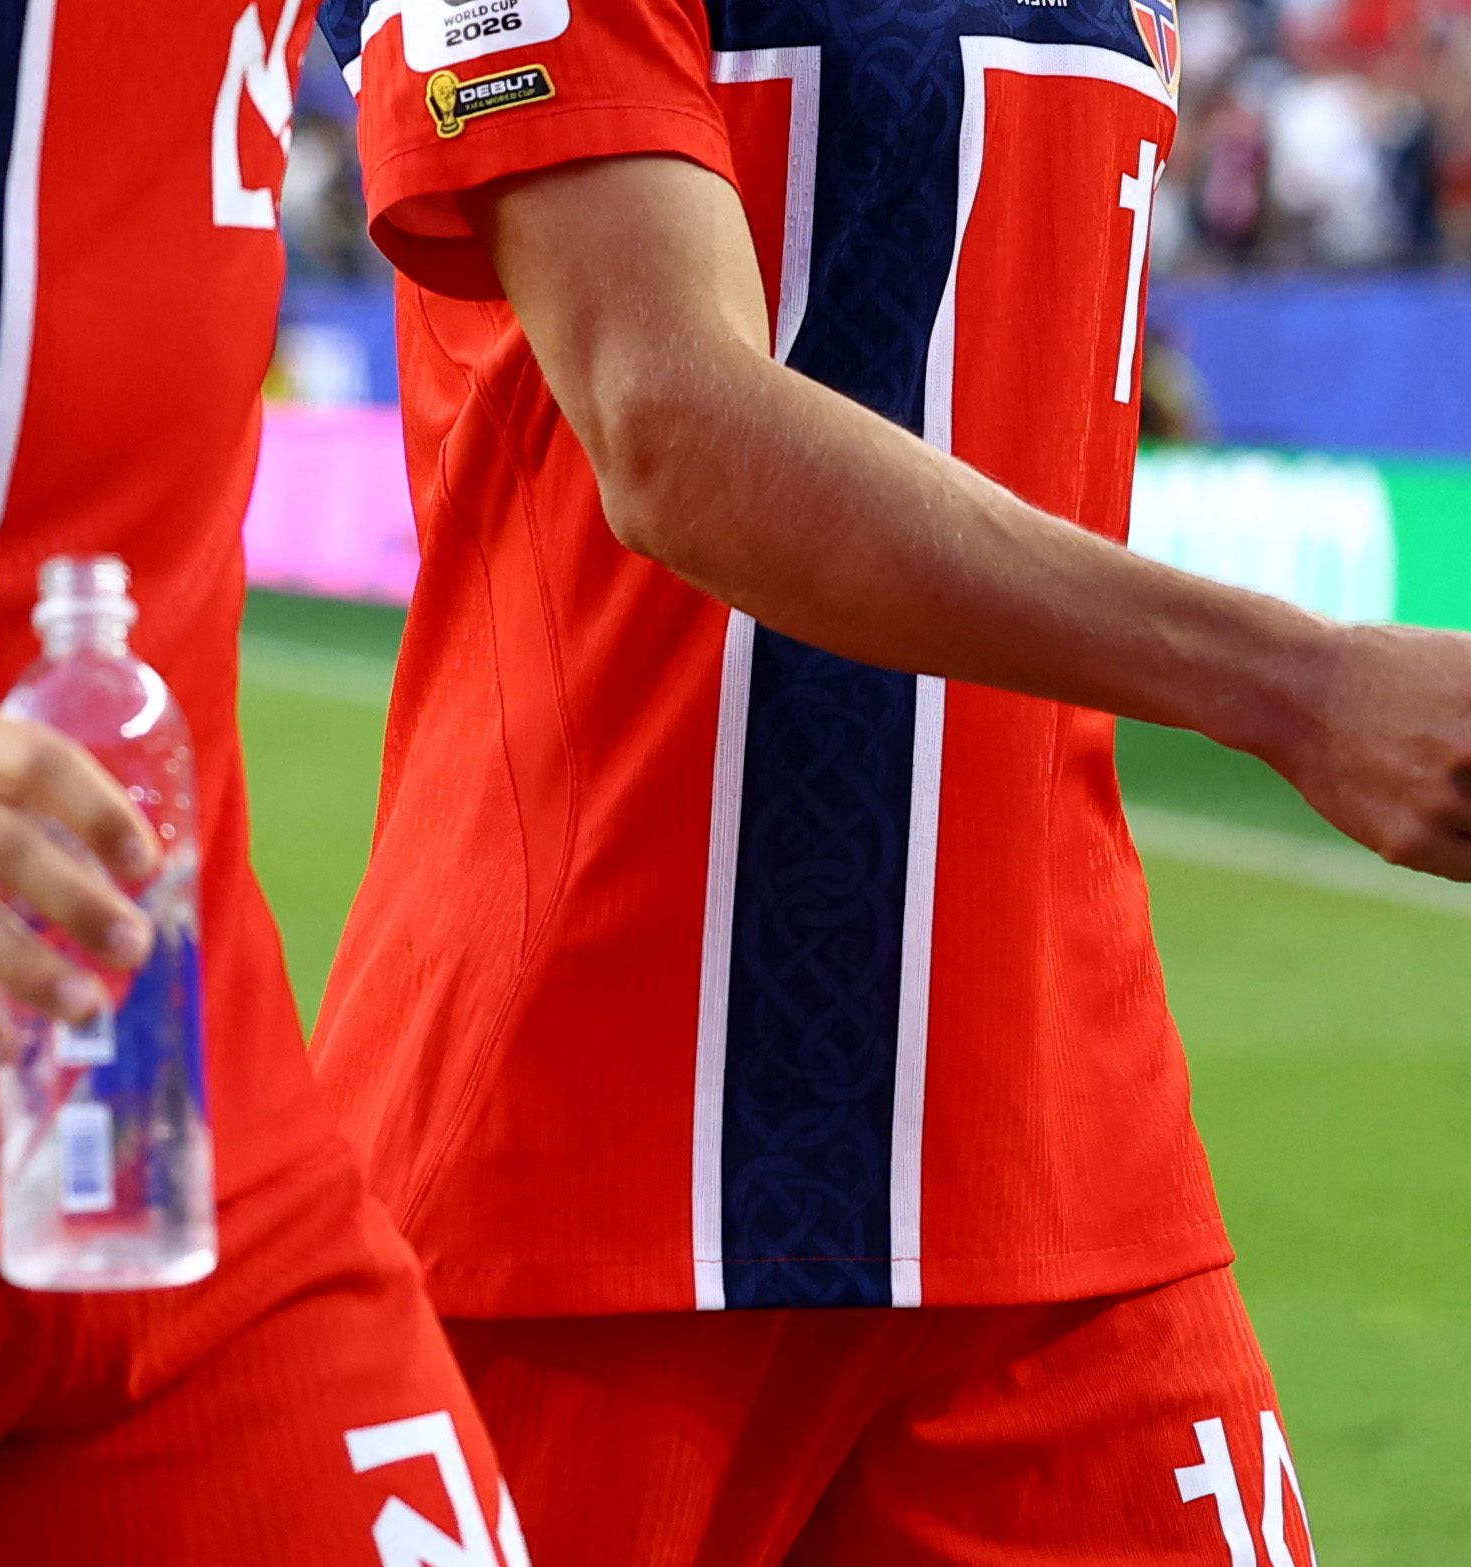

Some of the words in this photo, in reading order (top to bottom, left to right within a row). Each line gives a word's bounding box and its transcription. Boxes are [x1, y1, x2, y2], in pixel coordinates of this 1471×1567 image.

[444, 4, 489, 27] WORLD
[445, 12, 523, 47] 2026
[459, 72, 539, 103] DEBUT
[1113, 138, 1166, 405] 1
